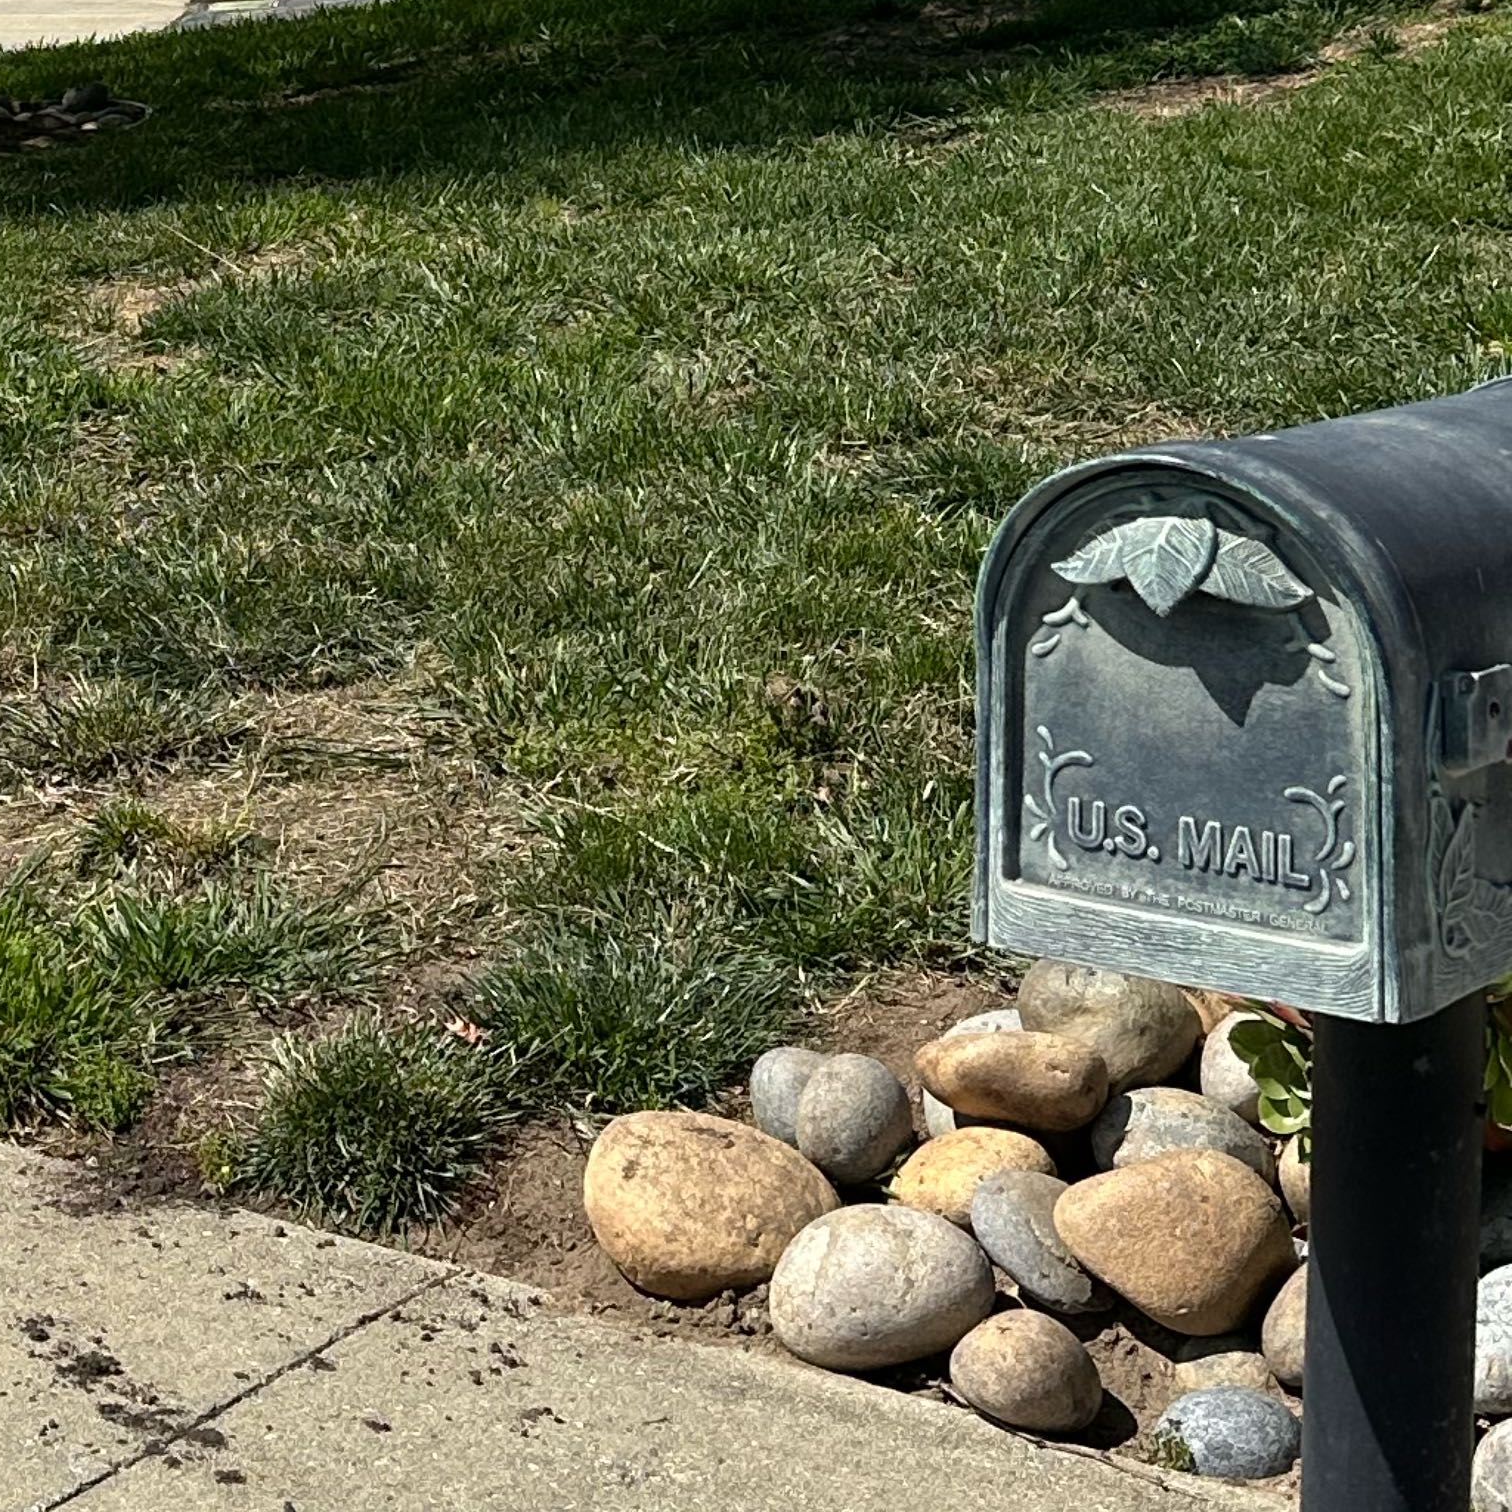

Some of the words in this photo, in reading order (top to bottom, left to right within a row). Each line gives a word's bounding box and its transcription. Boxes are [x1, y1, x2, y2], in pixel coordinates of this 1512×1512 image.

[1067, 796, 1159, 860] U.S.
[1178, 816, 1310, 887] MAIL
[1121, 885, 1137, 900] BY
[1177, 895, 1261, 923] POSTMASTER
[1269, 913, 1329, 933] GENERAL
